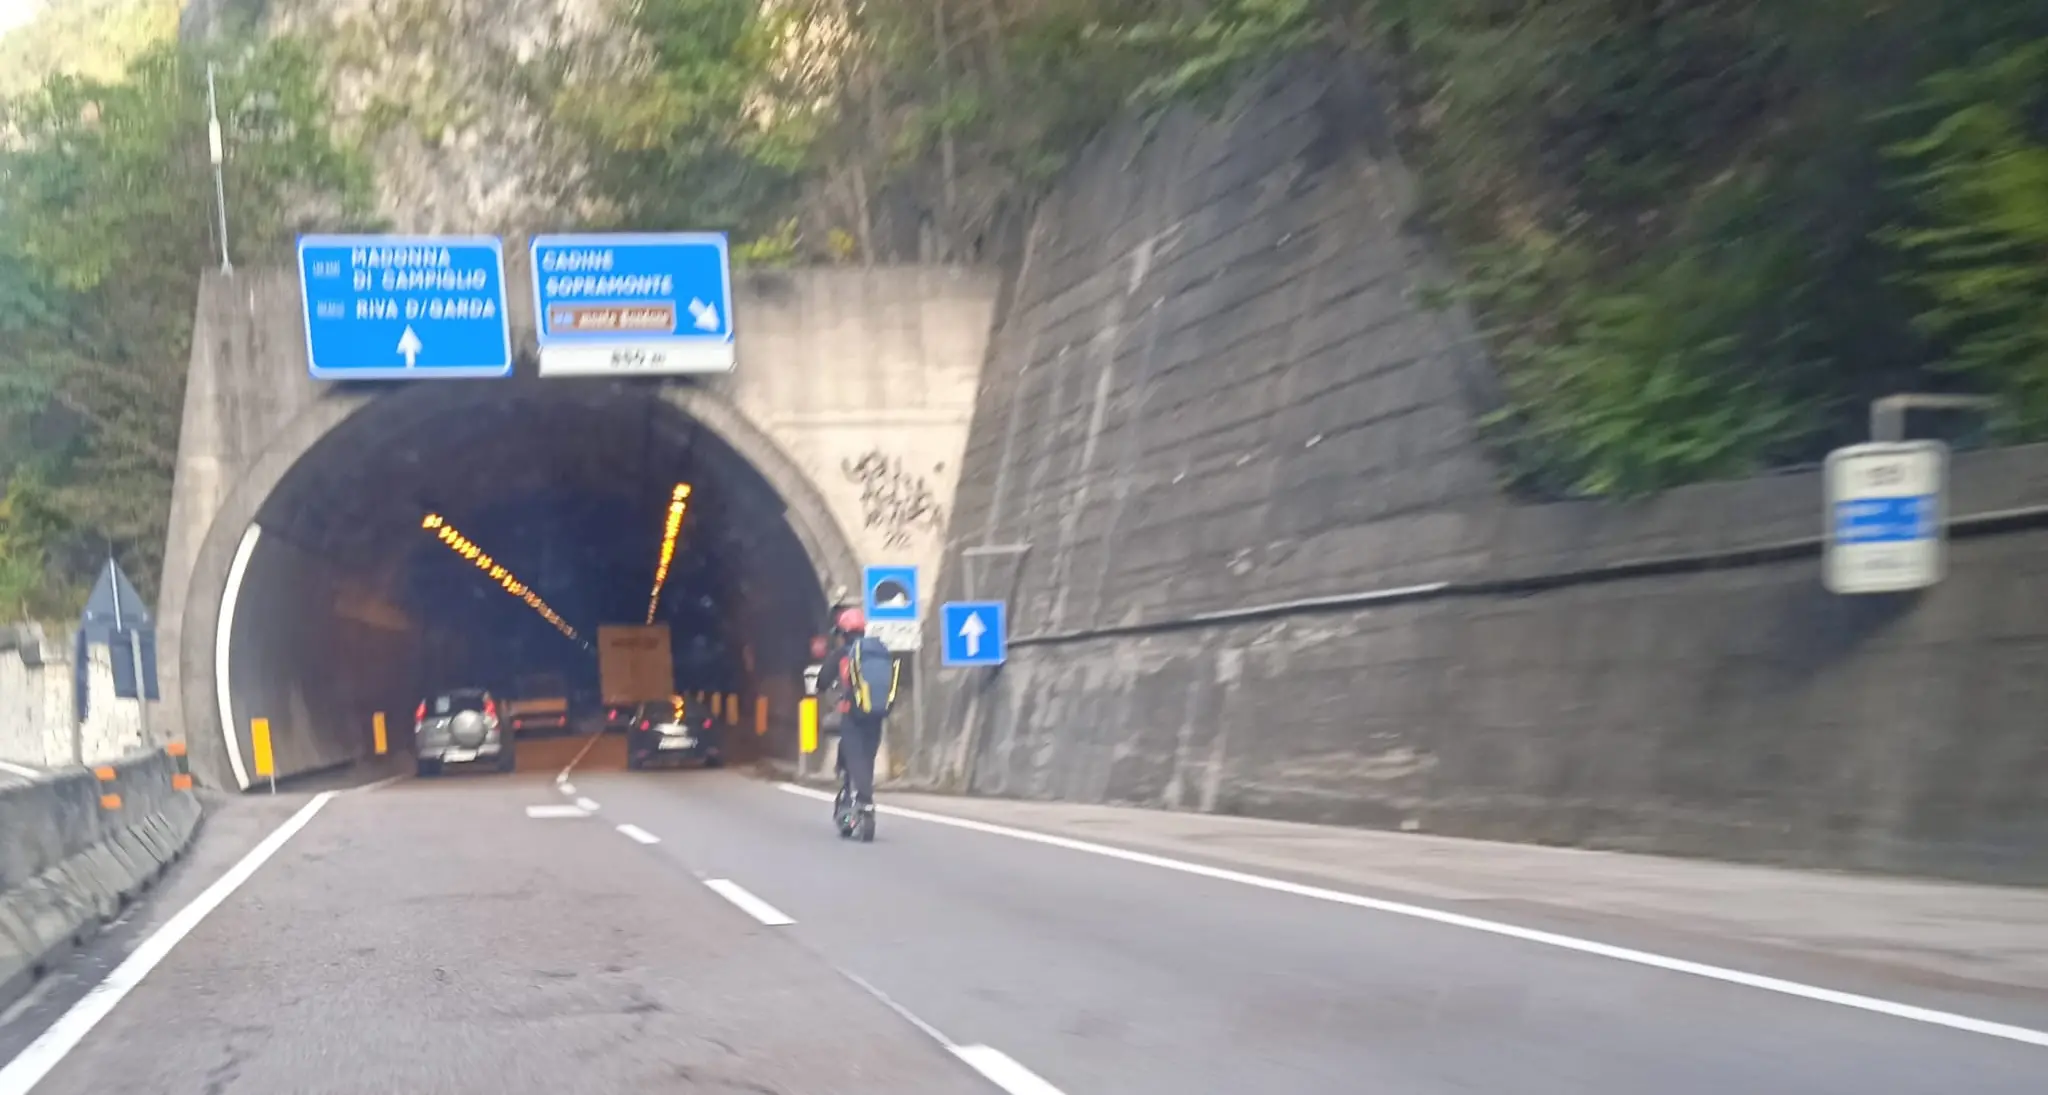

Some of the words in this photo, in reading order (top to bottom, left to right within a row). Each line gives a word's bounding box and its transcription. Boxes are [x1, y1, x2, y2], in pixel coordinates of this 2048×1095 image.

[352, 246, 450, 268] MADONNA
[542, 249, 614, 271] CADINE
[353, 269, 372, 291] DI
[382, 269, 487, 291] CAMPIGLIO
[546, 275, 673, 297] SOPRAMONTE
[356, 298, 398, 320] RIVA
